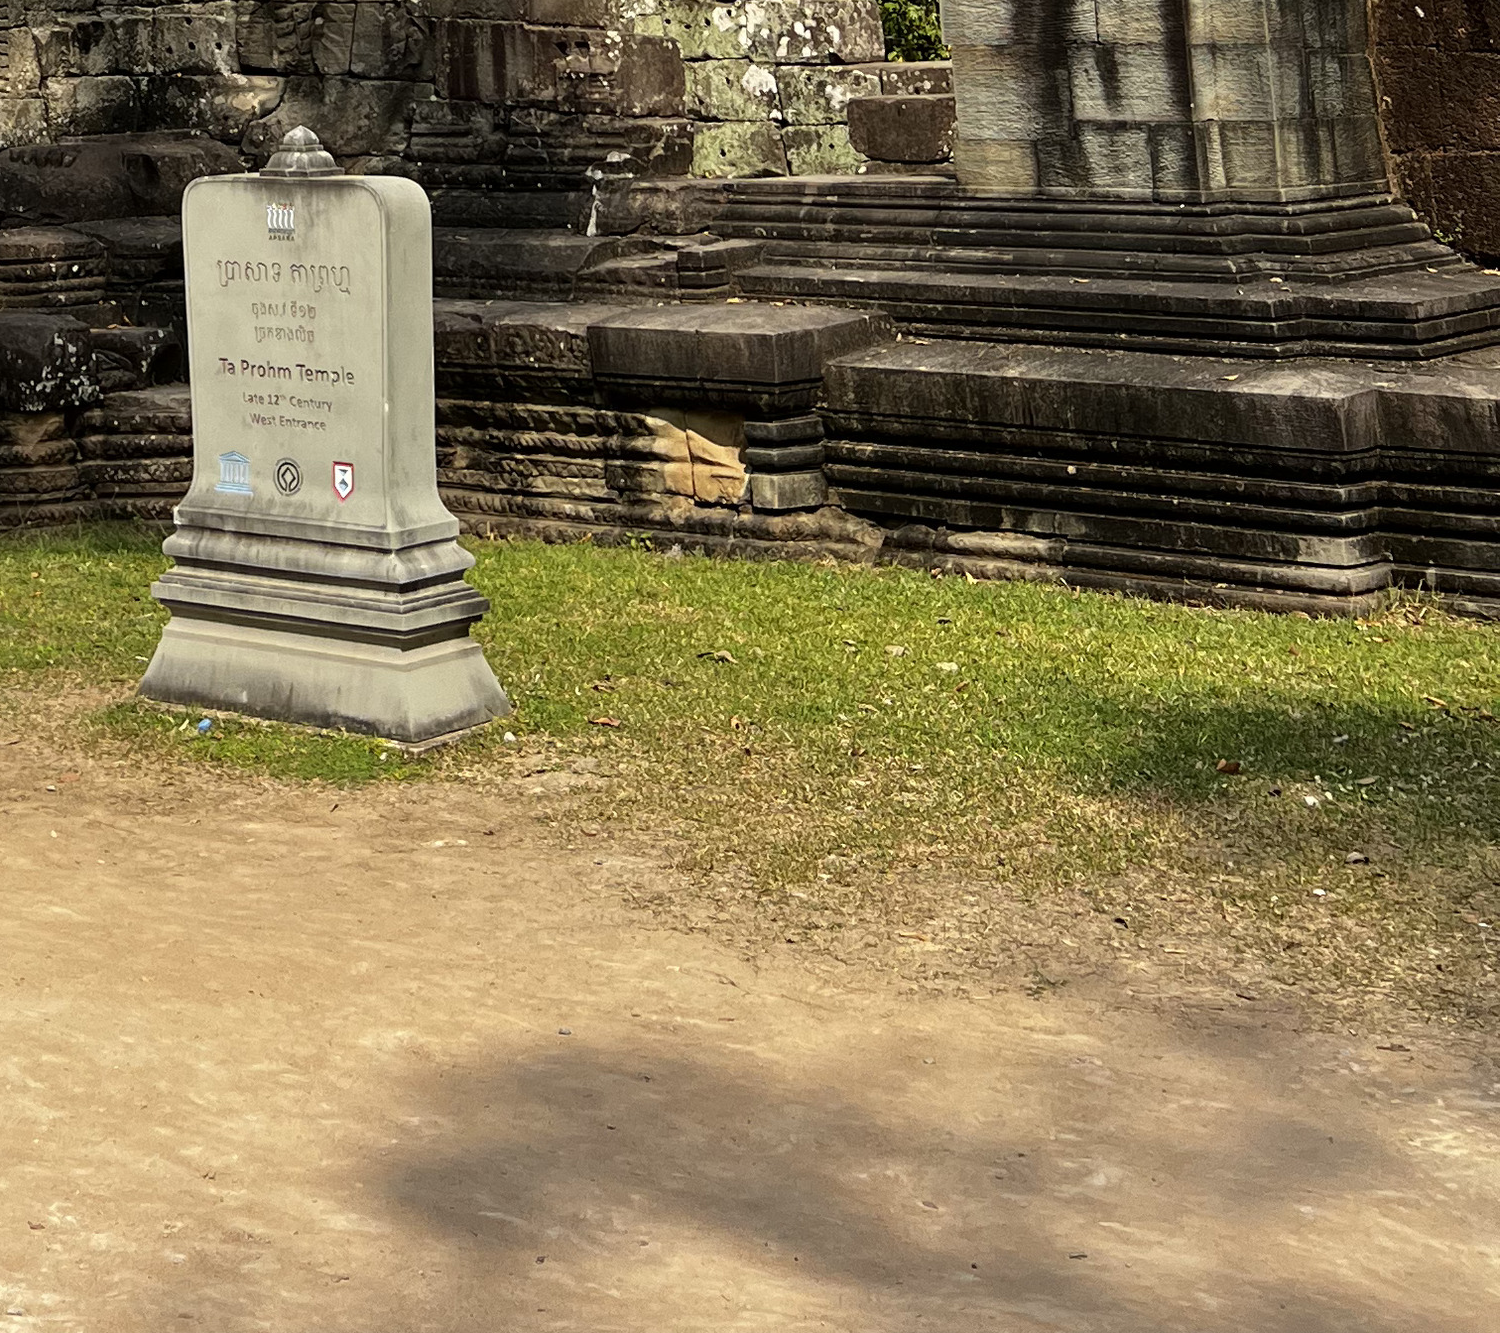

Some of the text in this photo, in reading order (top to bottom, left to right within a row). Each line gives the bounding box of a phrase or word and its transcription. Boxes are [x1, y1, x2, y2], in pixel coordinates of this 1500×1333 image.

[217, 260, 350, 295] ប្រាសាទ តាព្រហ្ម
[219, 357, 354, 387] Ta Prohm Temple
[243, 392, 265, 405] Late
[289, 395, 333, 412] Century
[250, 413, 326, 431] West Entrance
